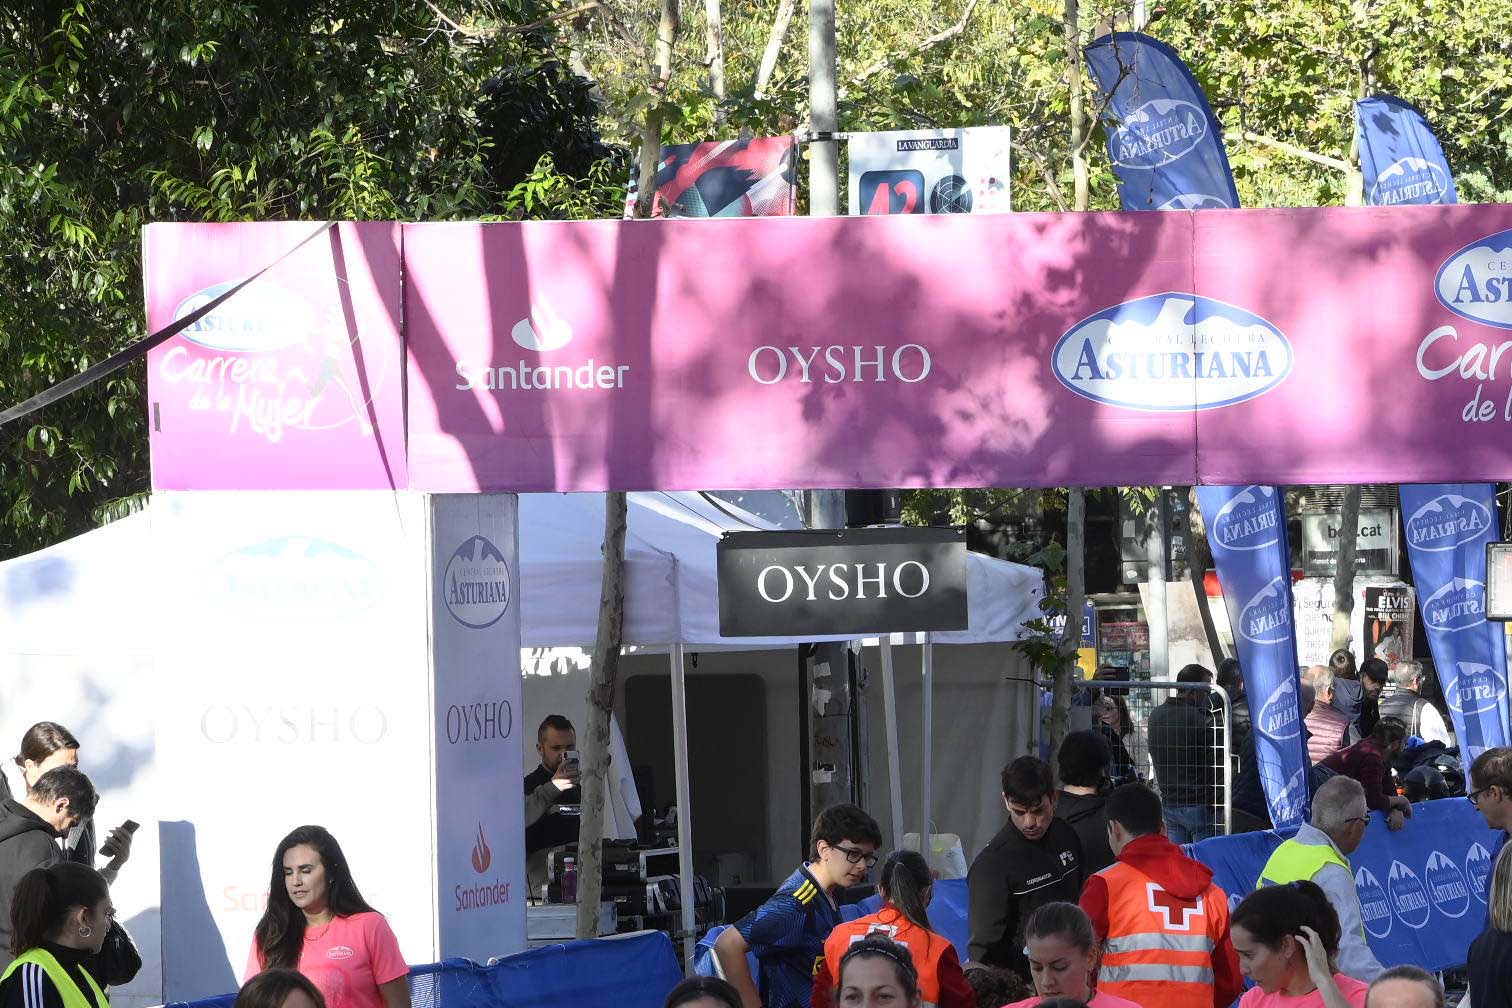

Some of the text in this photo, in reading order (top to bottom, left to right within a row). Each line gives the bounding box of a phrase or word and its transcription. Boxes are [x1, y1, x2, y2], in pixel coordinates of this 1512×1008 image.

[909, 139, 957, 150] VANGUARDIA
[455, 358, 629, 391] Santander
[748, 343, 931, 385] OYSHO
[1070, 337, 1275, 381] ASTURIANA
[1462, 383, 1497, 423] de
[449, 571, 507, 605] ASTURIANA
[757, 560, 930, 603] OYSHO
[1378, 595, 1409, 609] ELVIS
[200, 704, 389, 745] OYSHO
[446, 700, 513, 744] OYSHO
[455, 879, 511, 913] Santander
[1393, 889, 1428, 914] ASTURIANA
[1430, 878, 1466, 904] ASTURIANA
